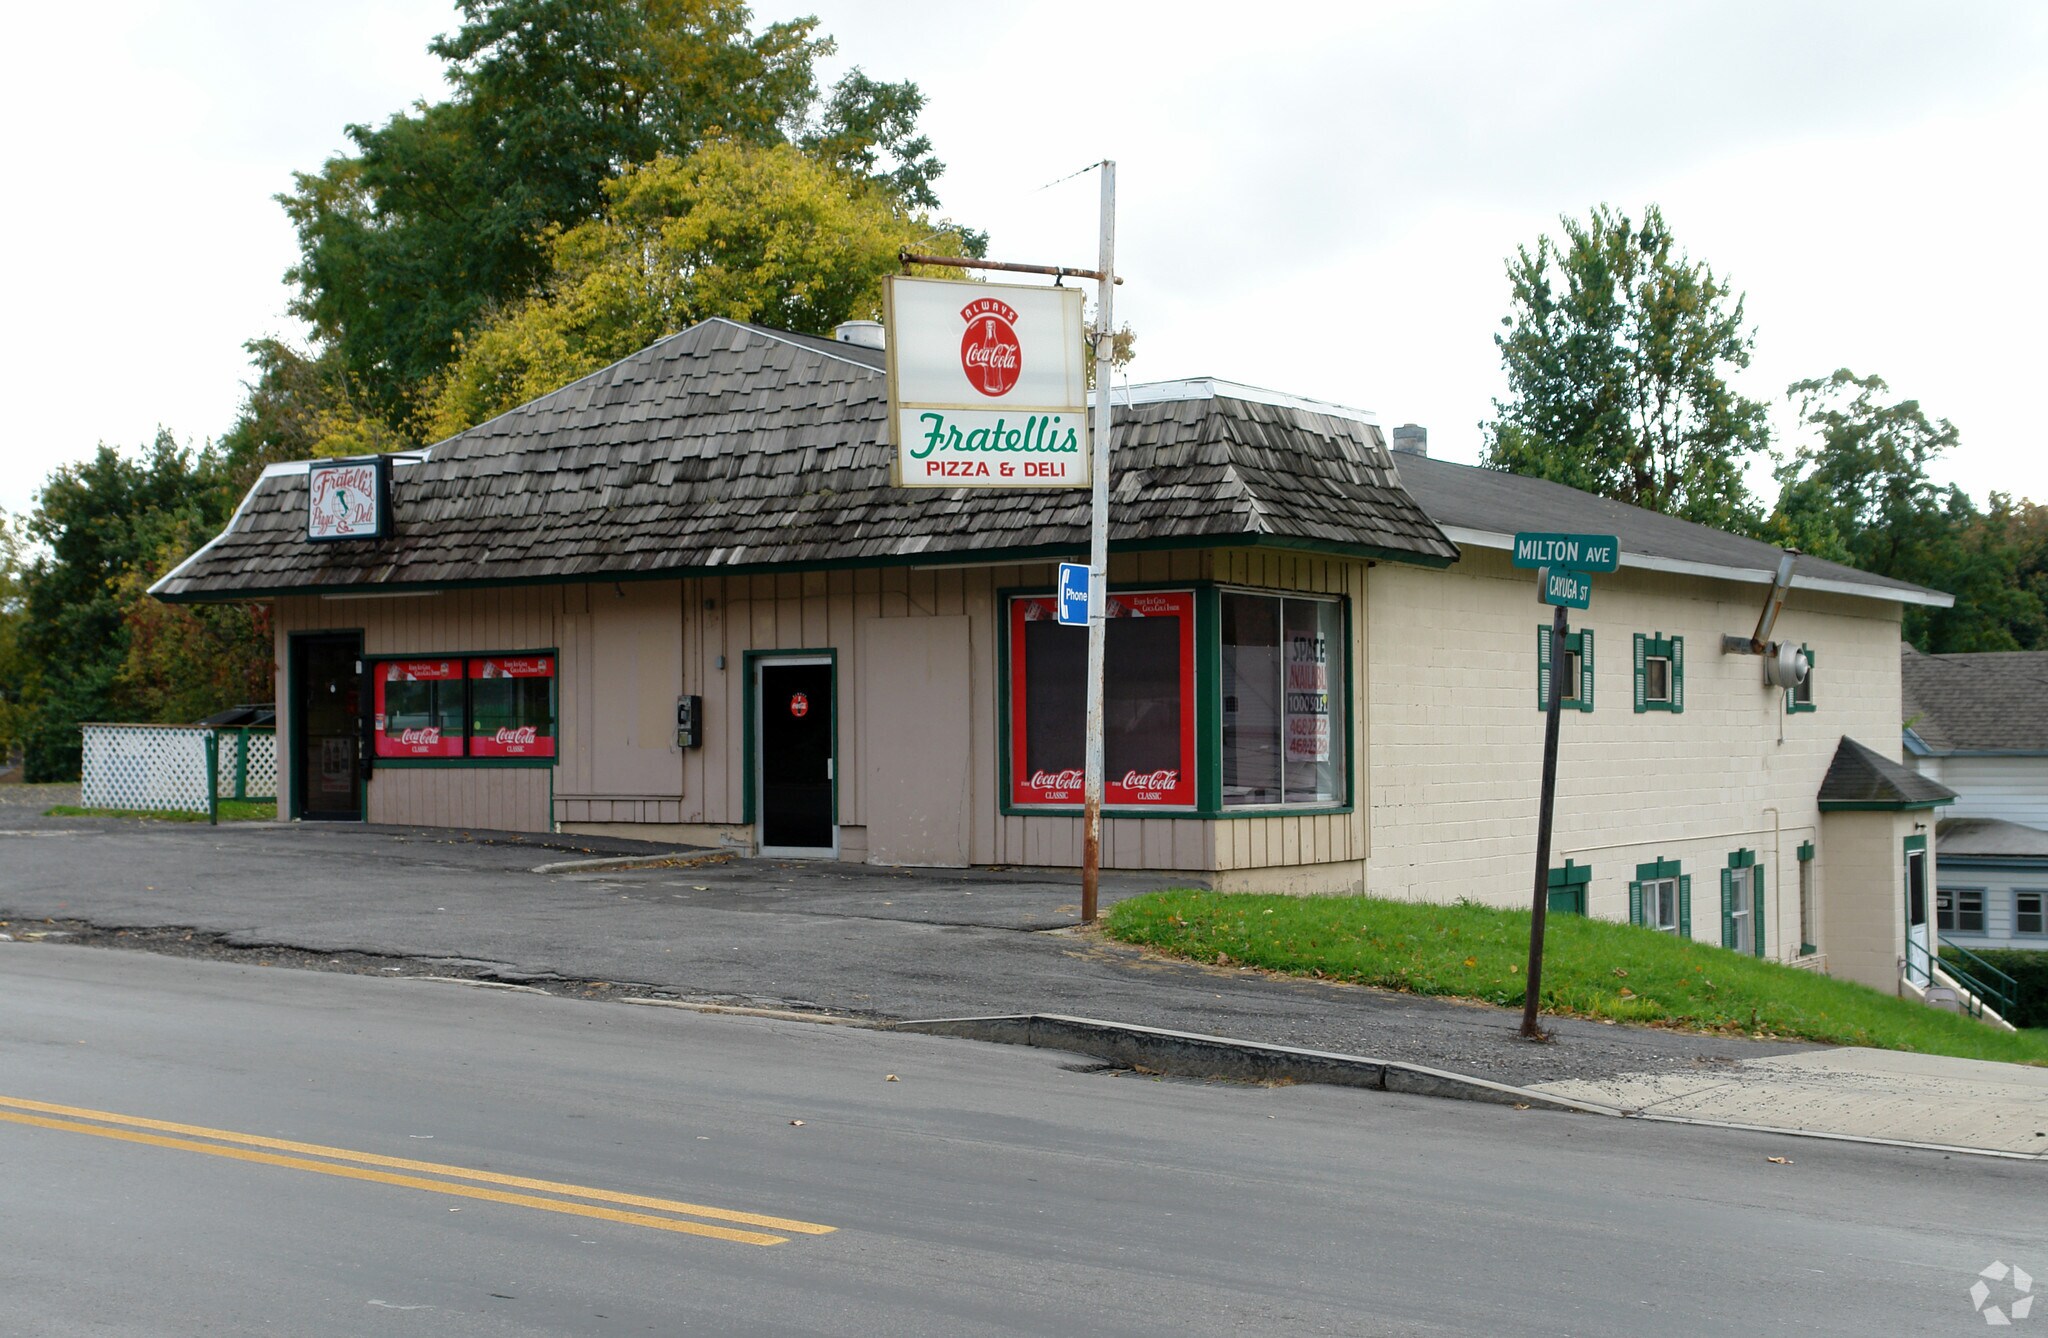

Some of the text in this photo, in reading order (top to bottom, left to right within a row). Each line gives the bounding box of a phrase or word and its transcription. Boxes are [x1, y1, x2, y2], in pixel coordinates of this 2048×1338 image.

[965, 301, 1015, 320] ALWAYS
[966, 342, 1017, 368] Coca-Cola
[910, 413, 1078, 459] Fratellis
[926, 461, 1065, 477] PIZZA & DELI
[312, 503, 373, 535] Pizza & Deli
[1518, 540, 1610, 563] MILTON AVE
[1066, 588, 1087, 602] Phone
[1549, 575, 1588, 601] CAYUGA ST
[1293, 636, 1325, 663] SPACE
[1289, 695, 1310, 712] 1000
[496, 726, 537, 744] Coca-Cola
[1031, 770, 1083, 790] Coca-Cola
[1123, 770, 1178, 790] Coca-Cola
[1045, 791, 1069, 800] CLASSIC
[1137, 792, 1162, 800] CLASSIC
